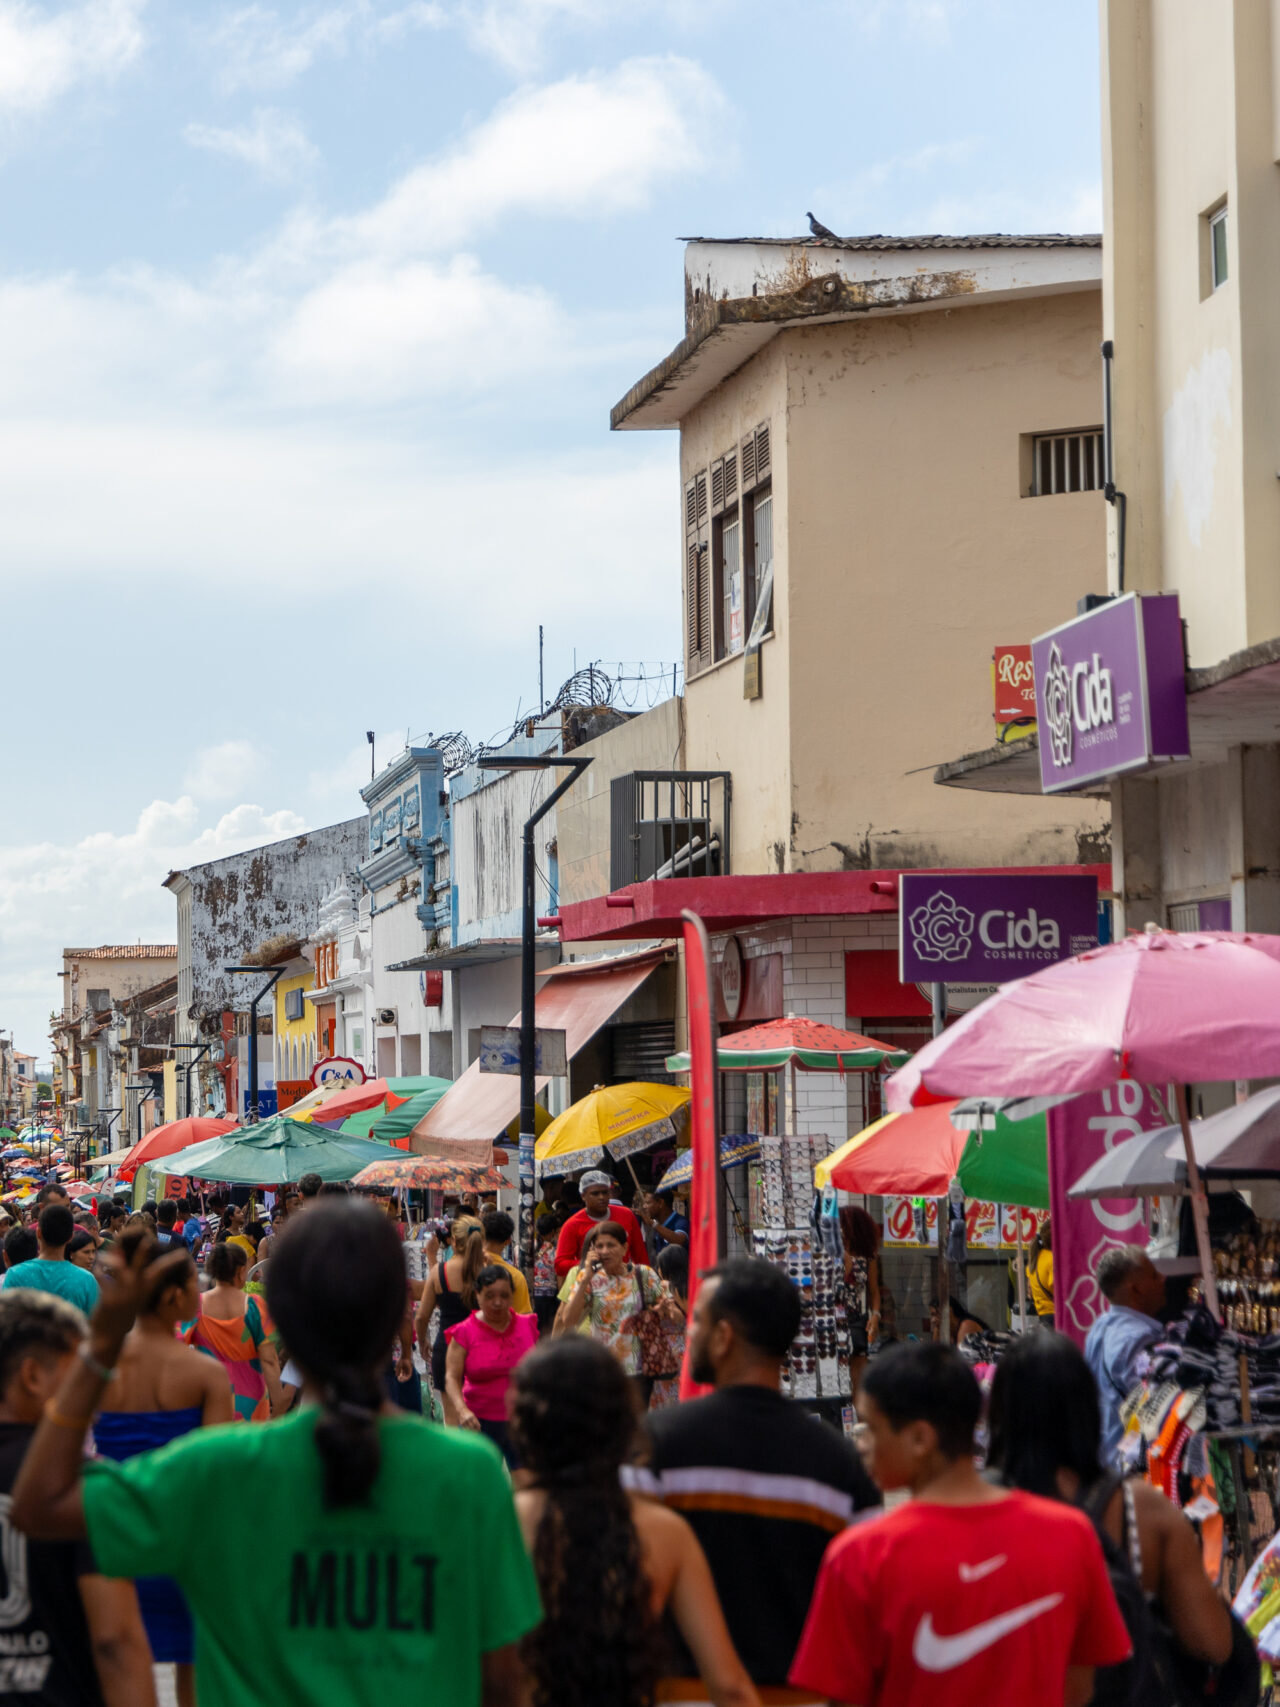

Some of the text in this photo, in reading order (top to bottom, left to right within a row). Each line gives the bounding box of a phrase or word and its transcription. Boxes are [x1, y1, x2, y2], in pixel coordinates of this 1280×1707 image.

[1072, 653, 1112, 731] Cida
[979, 908, 1060, 949] Cida
[289, 1551, 440, 1633] MULT
